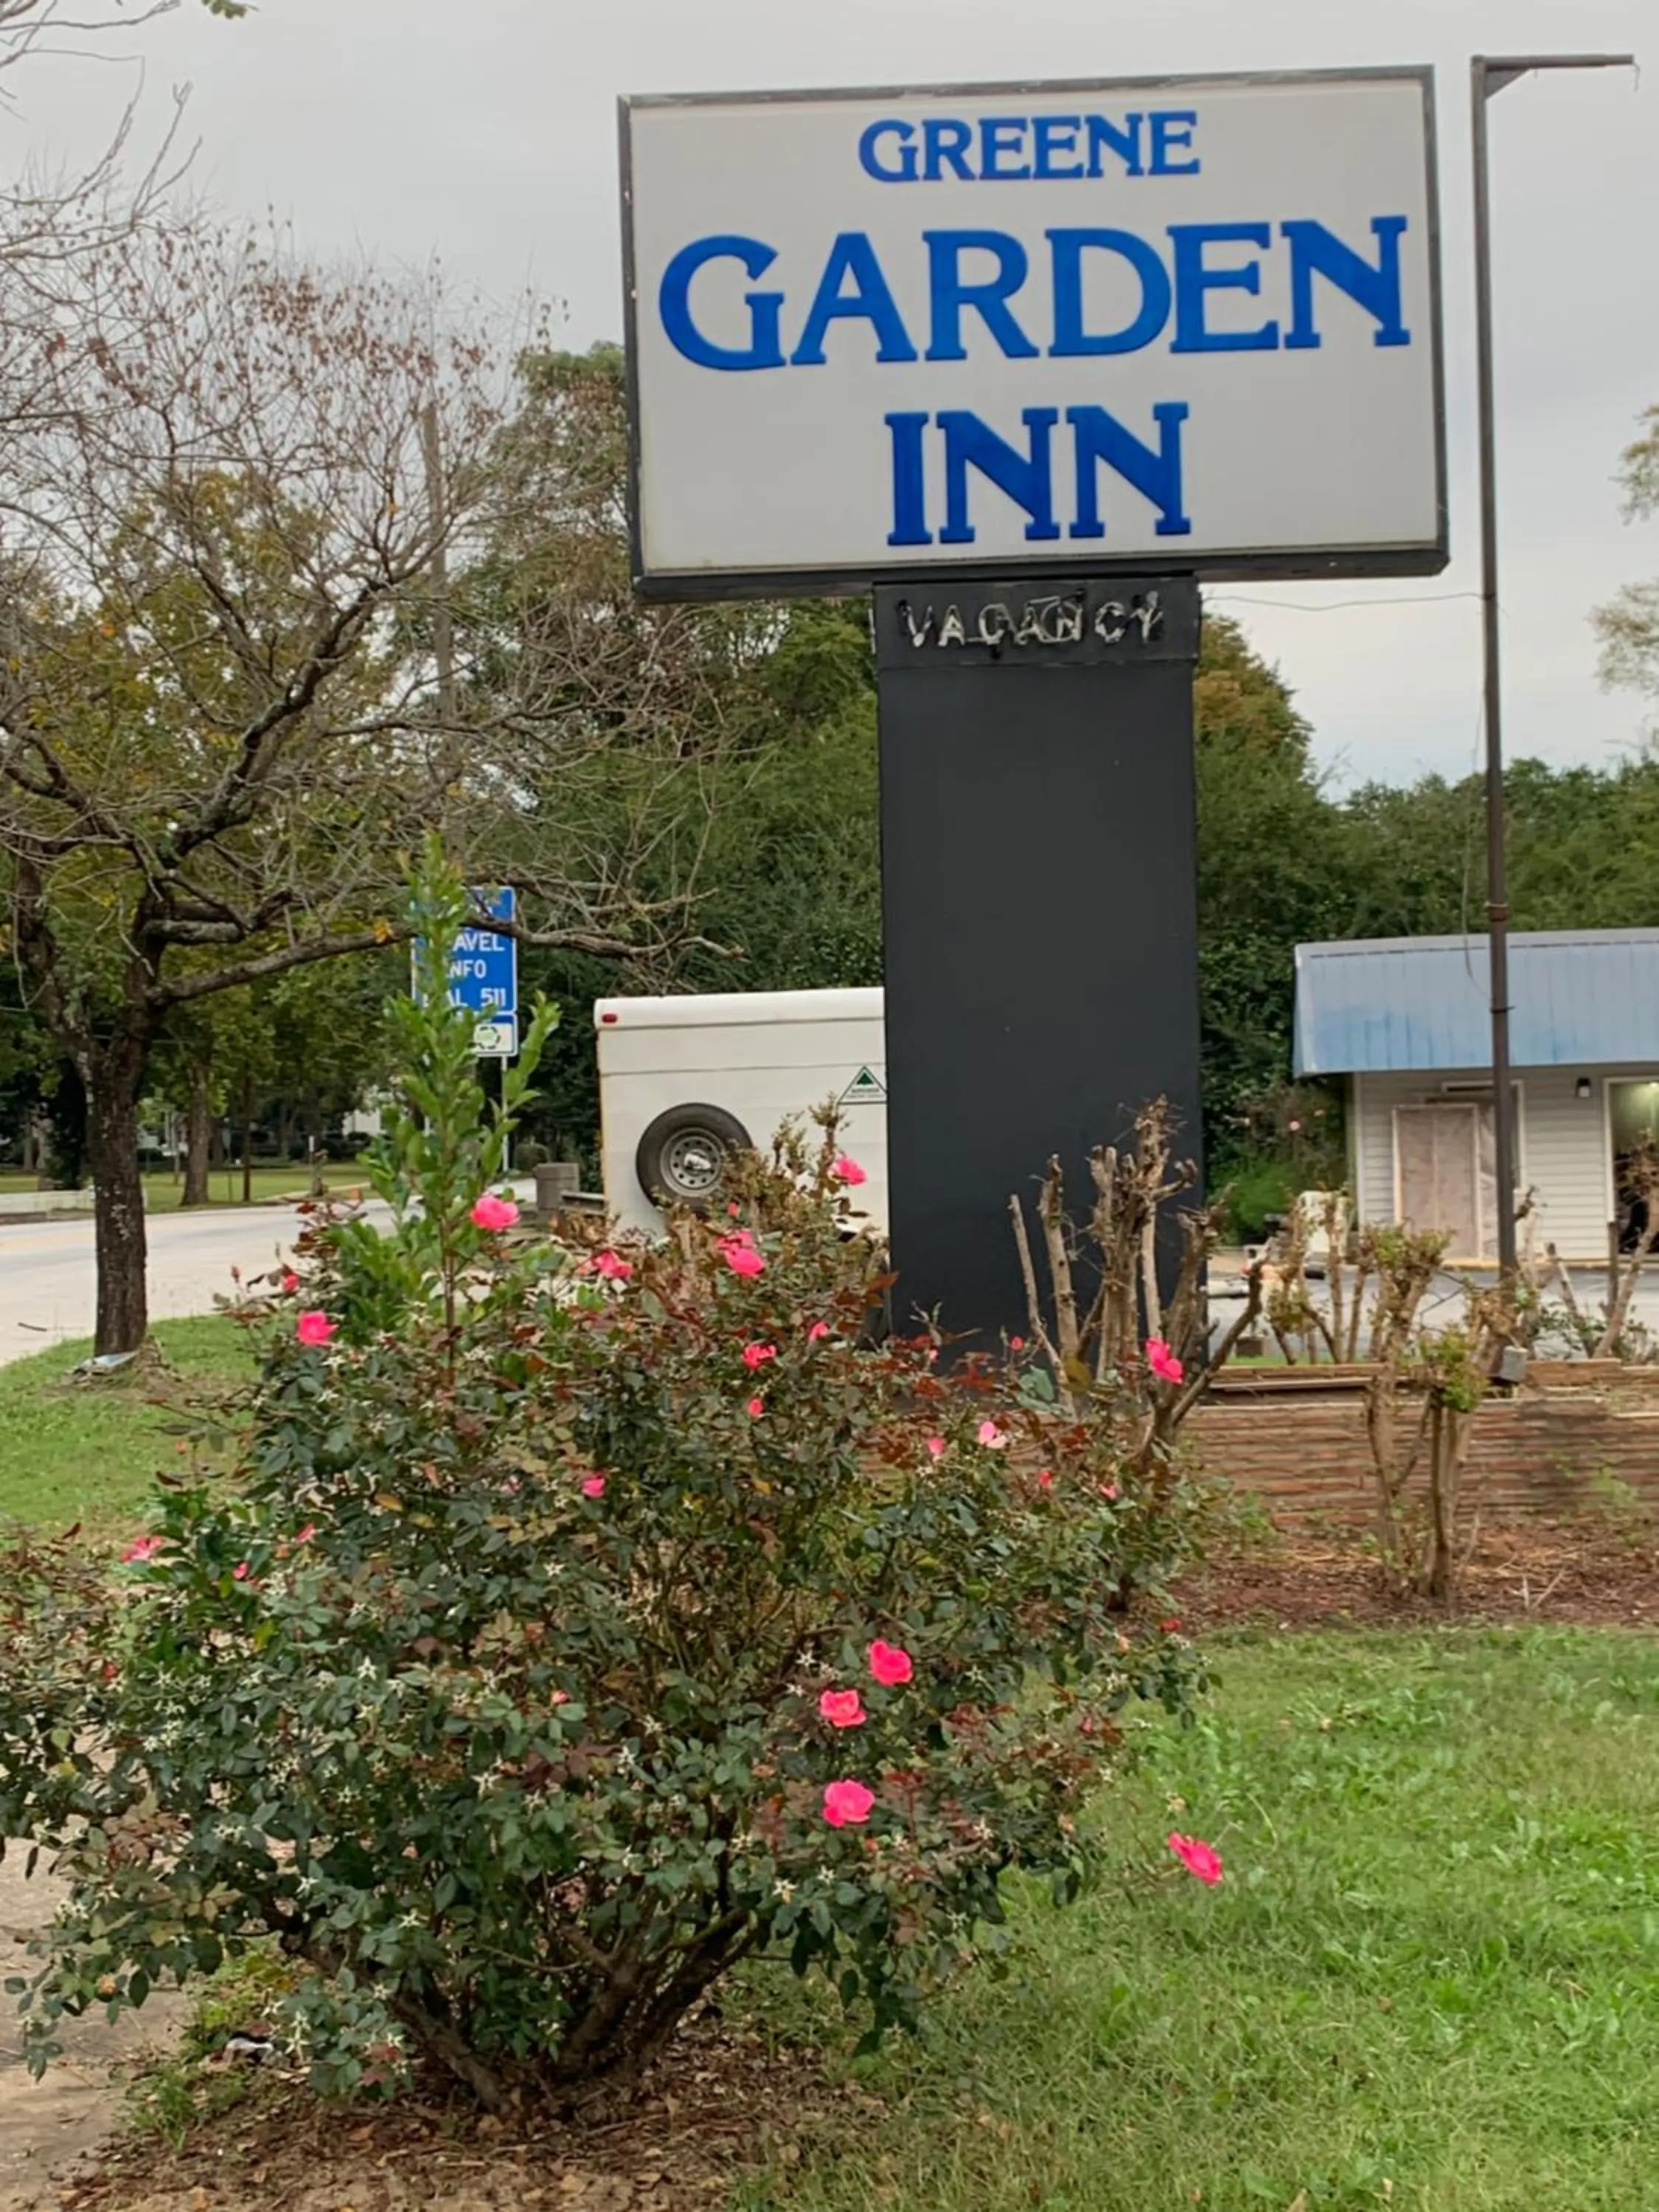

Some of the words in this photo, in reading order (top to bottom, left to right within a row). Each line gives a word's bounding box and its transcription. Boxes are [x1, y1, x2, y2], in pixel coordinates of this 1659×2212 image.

[860, 112, 1200, 181] GREENE
[659, 216, 1410, 371] GARDEN
[885, 402, 1190, 546] INN
[902, 594, 1164, 648] VACANCY
[439, 933, 504, 952] AVEL
[445, 959, 487, 979] NFO
[480, 987, 507, 1008] 511
